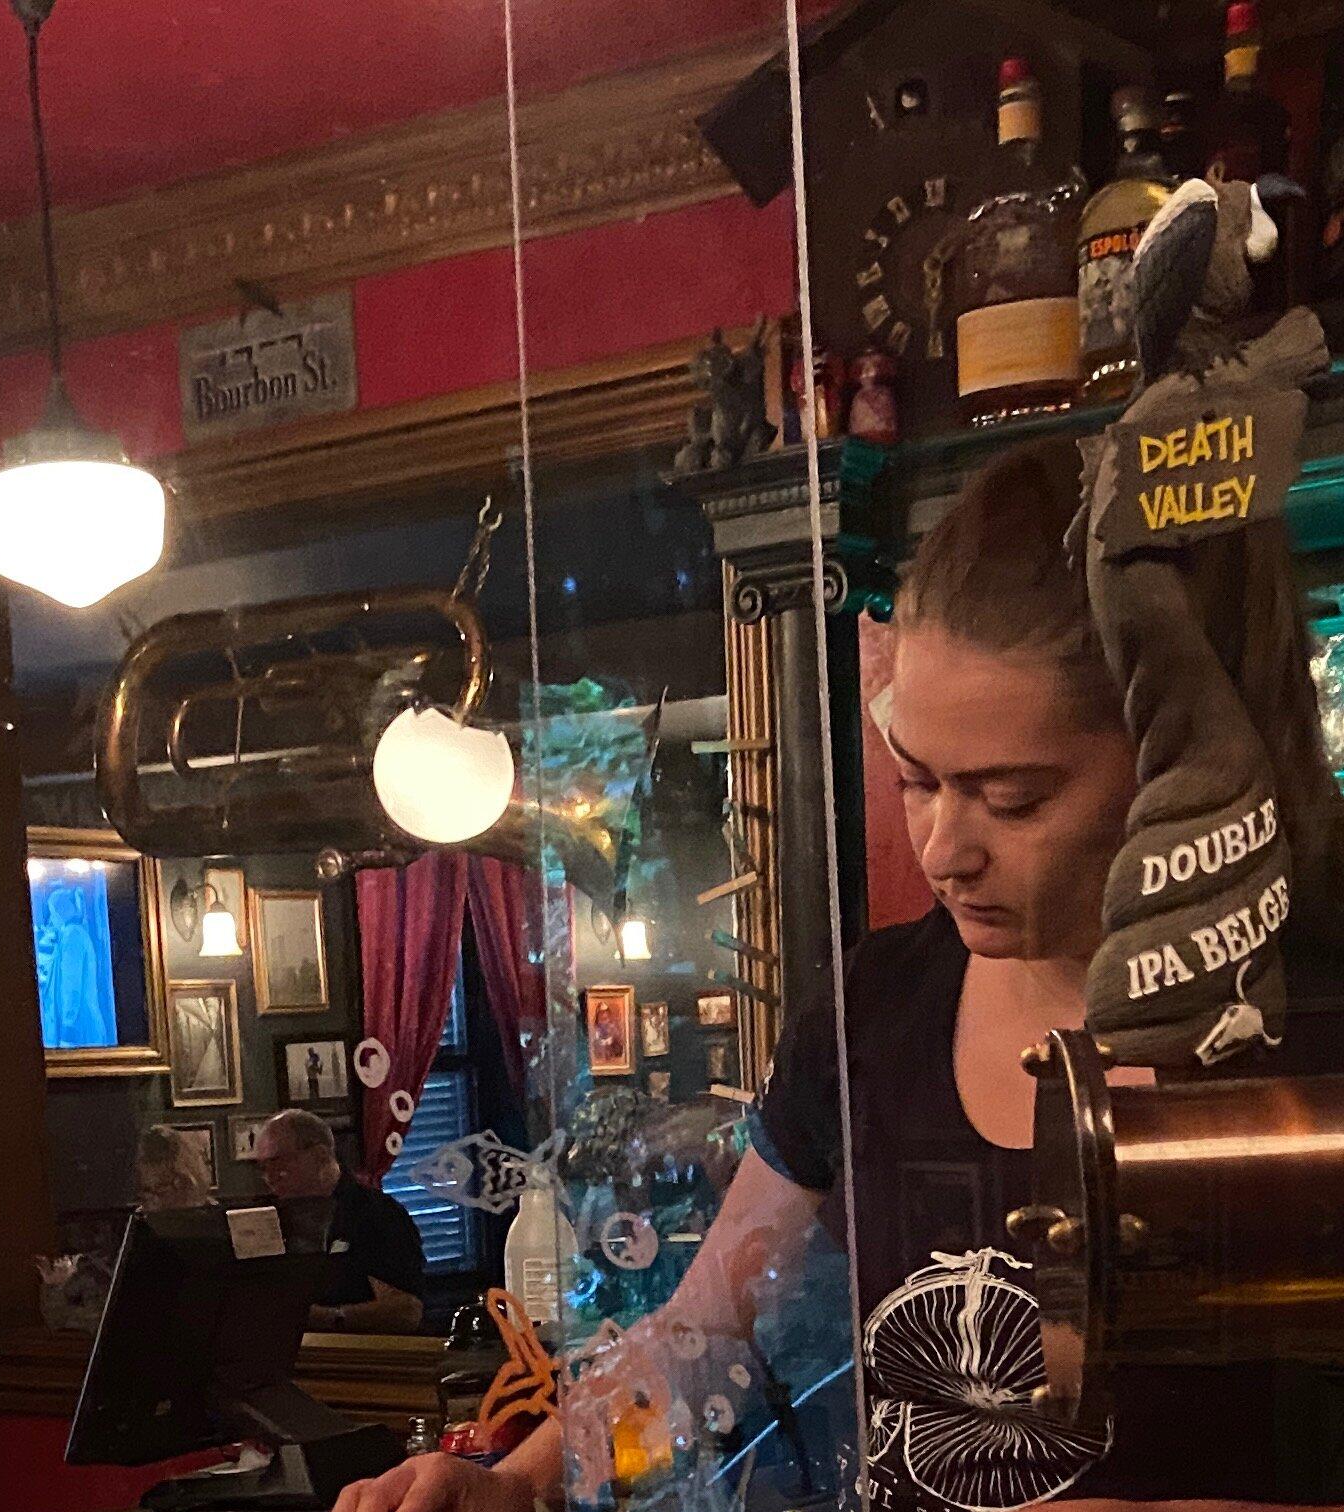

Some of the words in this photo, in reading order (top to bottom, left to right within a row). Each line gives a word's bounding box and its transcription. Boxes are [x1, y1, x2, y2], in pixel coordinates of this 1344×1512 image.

[192, 371, 297, 420] Bourbon
[1139, 415, 1253, 473] DEATH
[1139, 475, 1256, 530] VALLEY
[1141, 798, 1277, 896] DOUBLE
[1126, 943, 1195, 1000] IPA
[1191, 875, 1290, 972] BELGE
